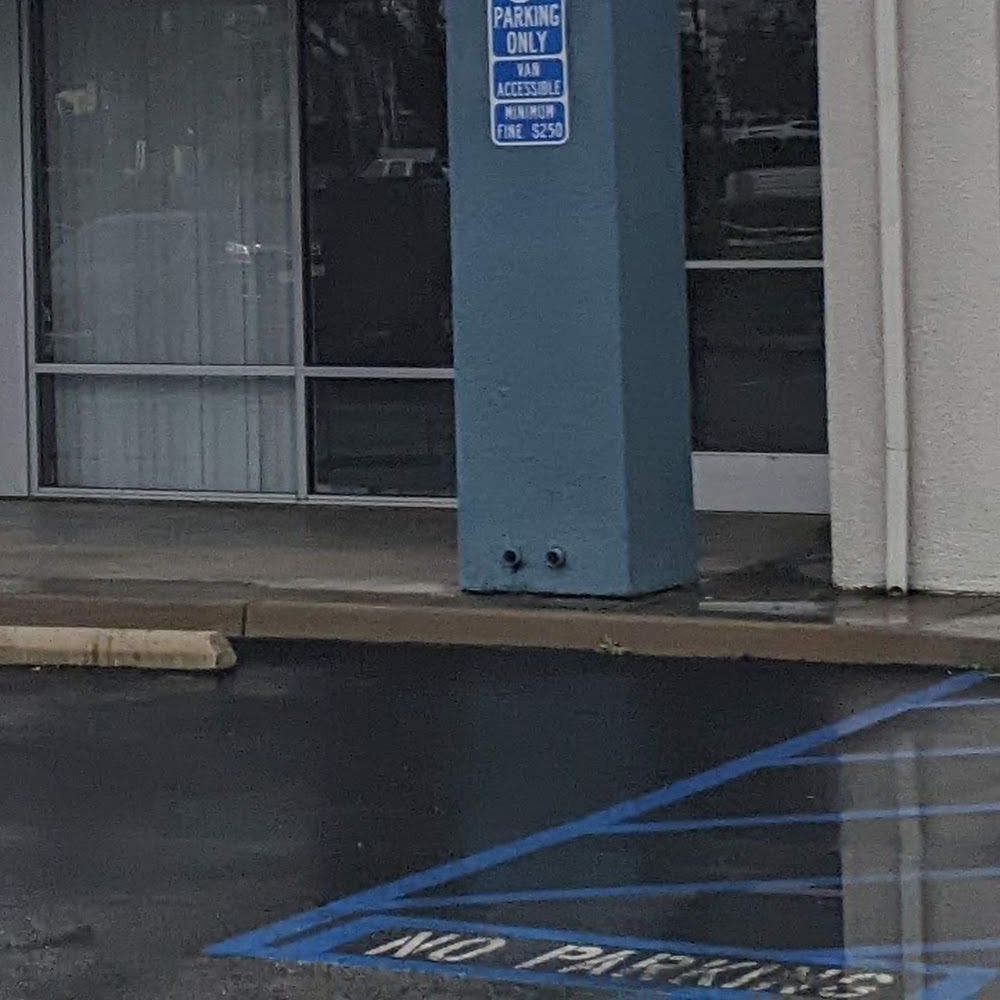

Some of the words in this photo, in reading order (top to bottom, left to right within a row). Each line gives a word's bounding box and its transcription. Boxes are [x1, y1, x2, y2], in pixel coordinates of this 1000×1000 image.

[493, 4, 559, 29] PARKING
[506, 30, 548, 54] ONLY
[516, 62, 541, 78] VAN
[496, 80, 562, 97] ACCESSIBLE
[504, 104, 555, 120] MINIMUM
[497, 124, 523, 139] FINE
[531, 123, 564, 139] $250
[364, 930, 507, 962] NO
